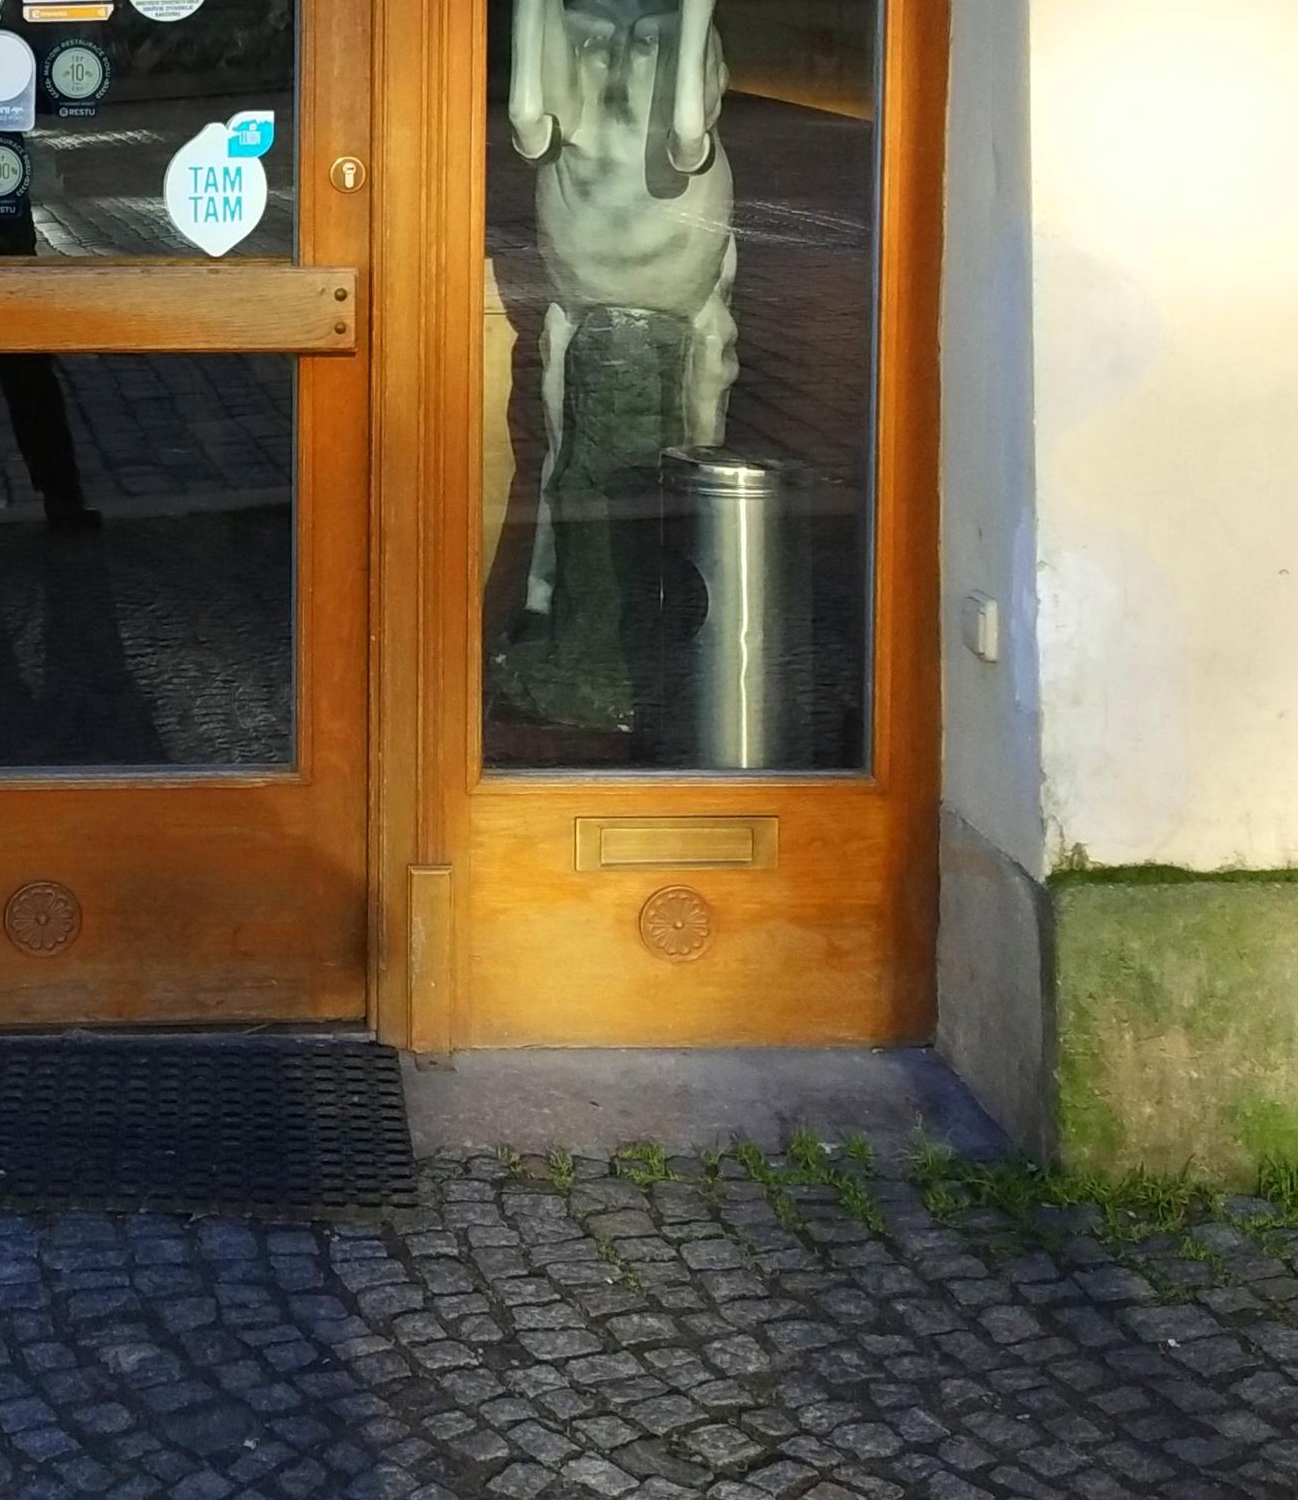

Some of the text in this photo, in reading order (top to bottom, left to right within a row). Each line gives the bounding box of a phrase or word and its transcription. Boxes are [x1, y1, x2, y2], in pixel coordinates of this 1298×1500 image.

[70, 63, 84, 82] 10
[68, 108, 96, 117] RESTU
[188, 166, 243, 193] TAM
[188, 196, 243, 223] TAM
